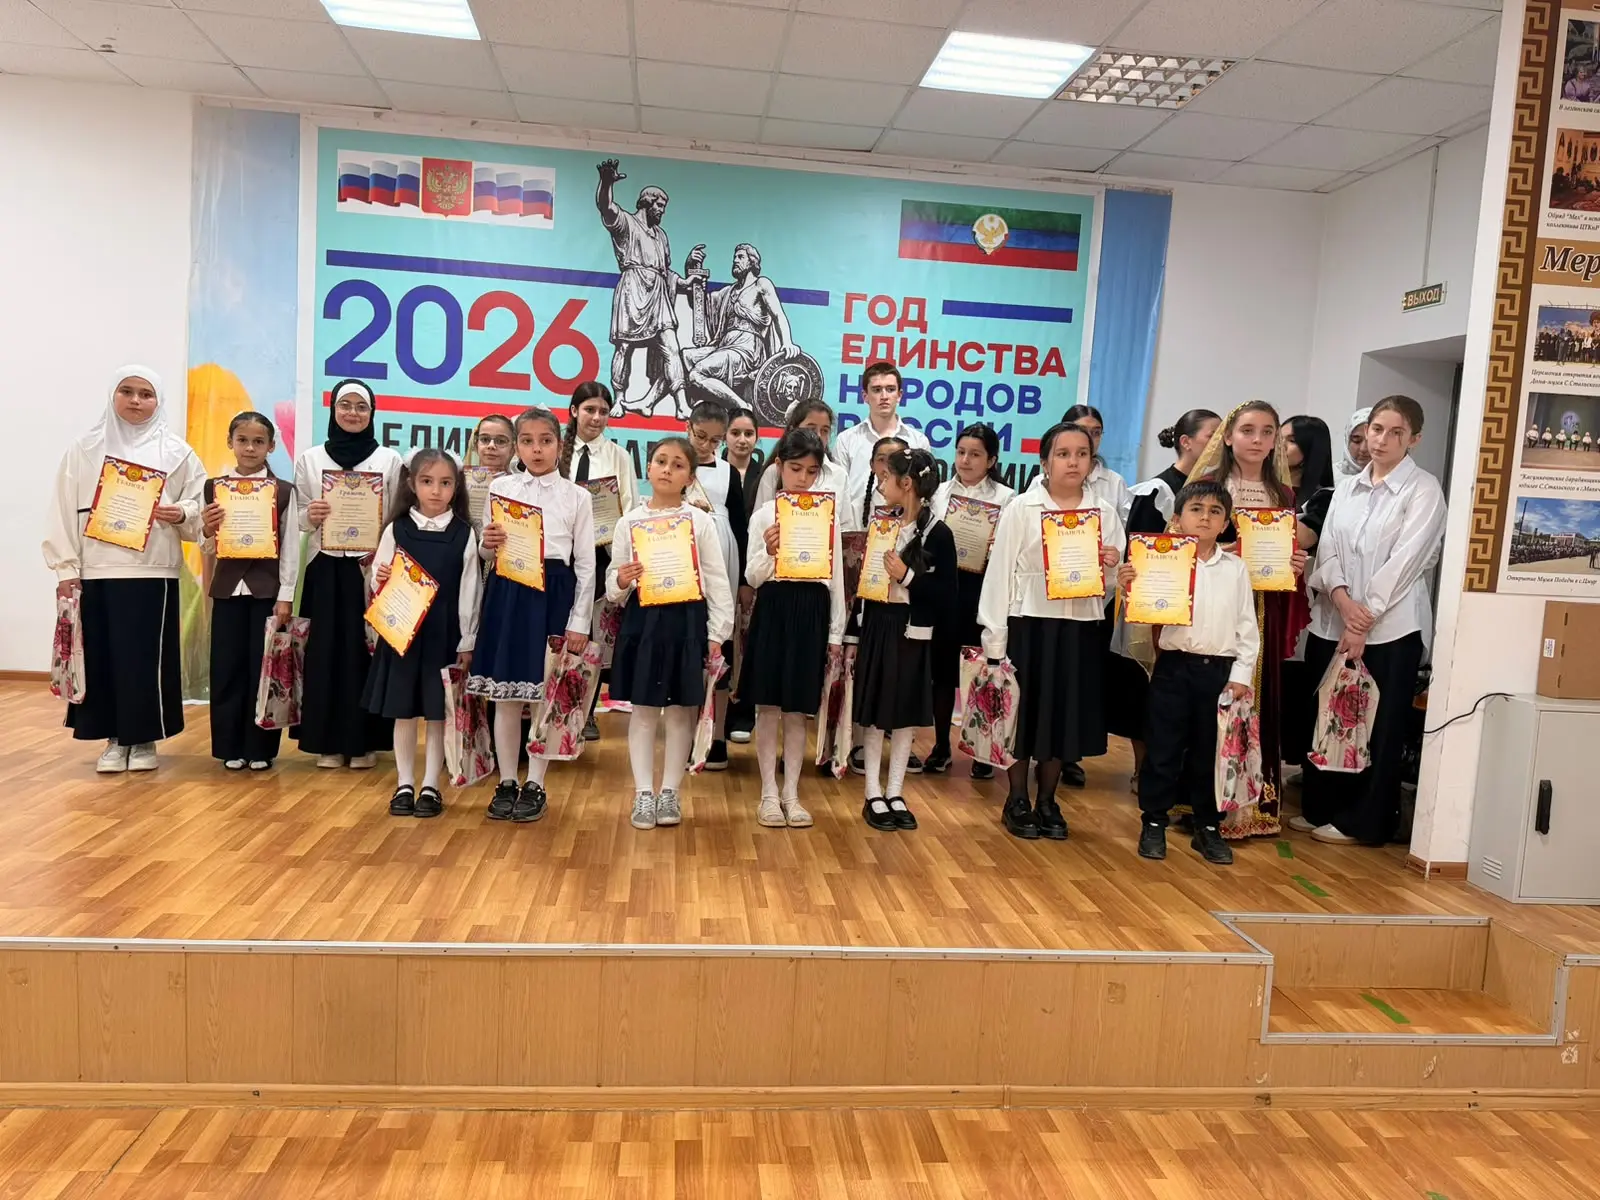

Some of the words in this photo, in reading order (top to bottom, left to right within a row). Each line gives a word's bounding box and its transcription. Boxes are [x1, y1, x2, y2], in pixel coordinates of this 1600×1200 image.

[1539, 245, 1600, 282] Мер
[844, 292, 928, 334] ГОД
[1407, 288, 1440, 306] ВЫХОД
[323, 279, 600, 395] 2026
[841, 333, 1067, 377] ЕДИНСТВА
[839, 373, 1042, 417] НРОДОВ
[1506, 574, 1536, 583] Открытие
[1554, 576, 1574, 584] Победы
